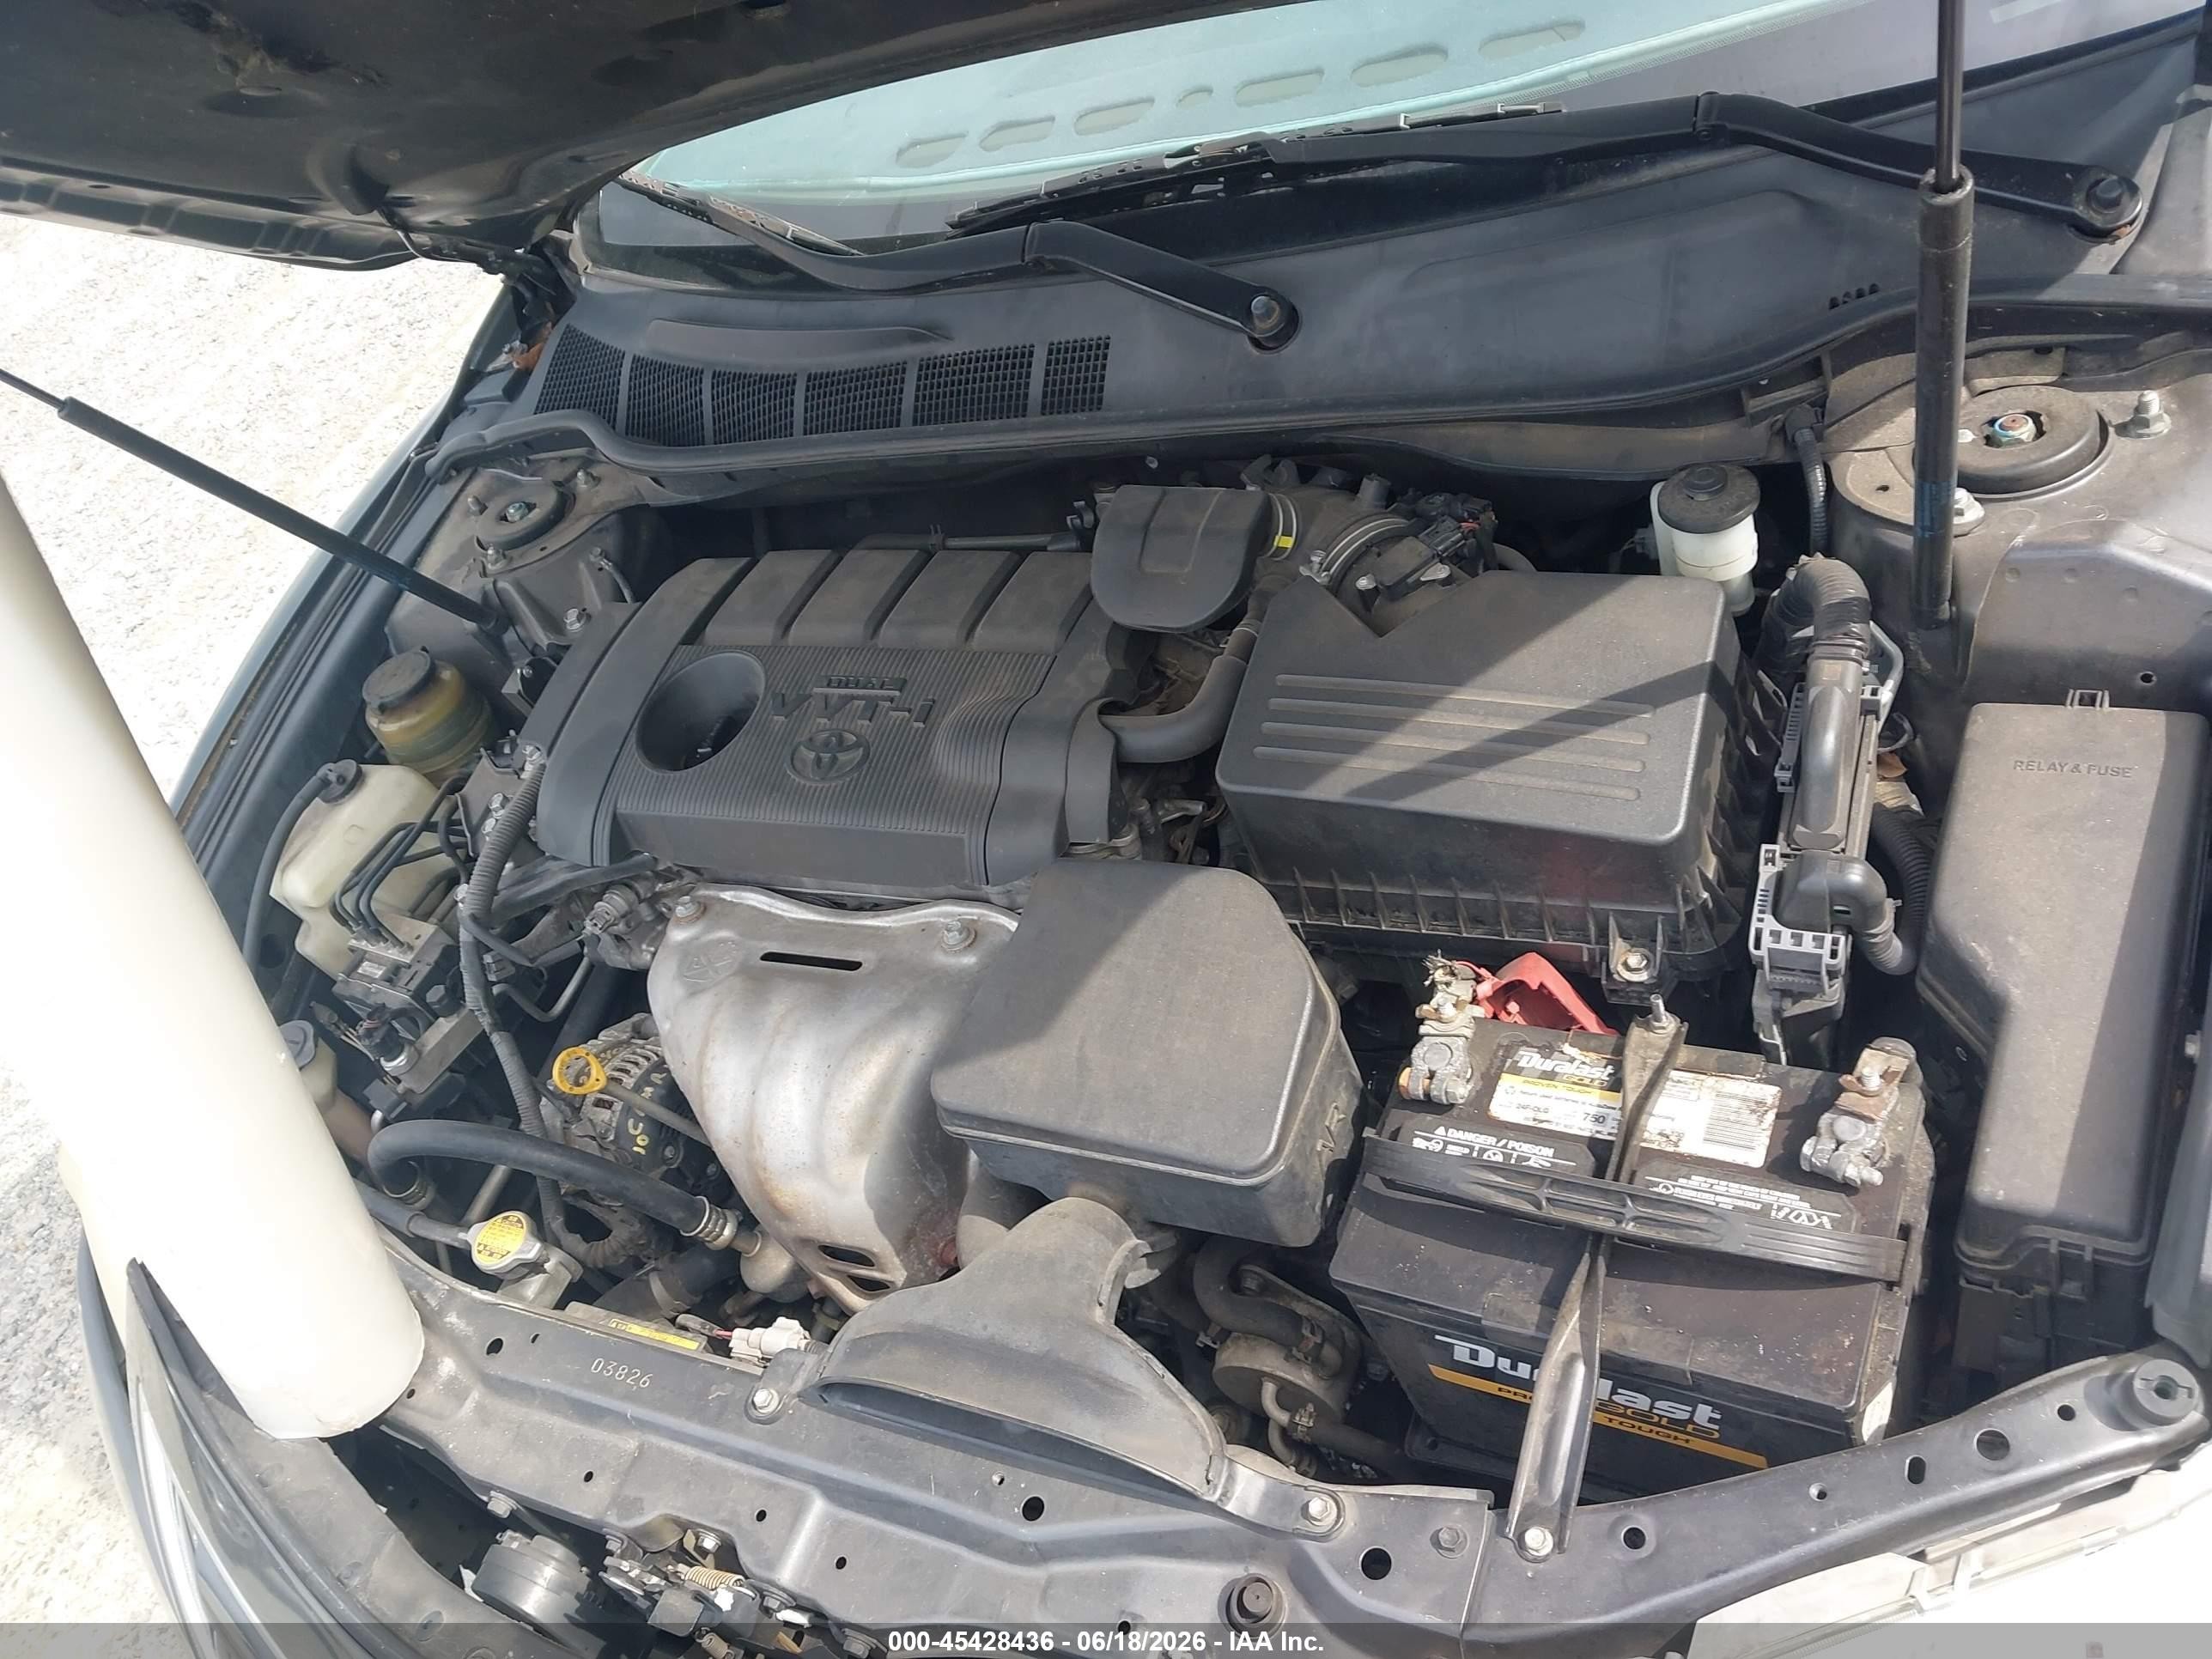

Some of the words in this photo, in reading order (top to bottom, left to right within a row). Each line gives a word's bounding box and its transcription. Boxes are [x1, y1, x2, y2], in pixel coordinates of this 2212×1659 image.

[2013, 759, 2069, 773] RELAY
[2070, 763, 2081, 774] &
[2087, 763, 2133, 778] FUSE
[1517, 1050, 1615, 1080] Duralast
[1562, 1074, 1608, 1088] GOLD
[1583, 1112, 1607, 1125] 750
[1448, 1127, 1497, 1145] DANGER
[1507, 1139, 1555, 1158] POISON
[591, 1358, 653, 1388] 03826
[1434, 1334, 1723, 1431] Dulast
[1603, 1415, 1692, 1444] TOUGH
